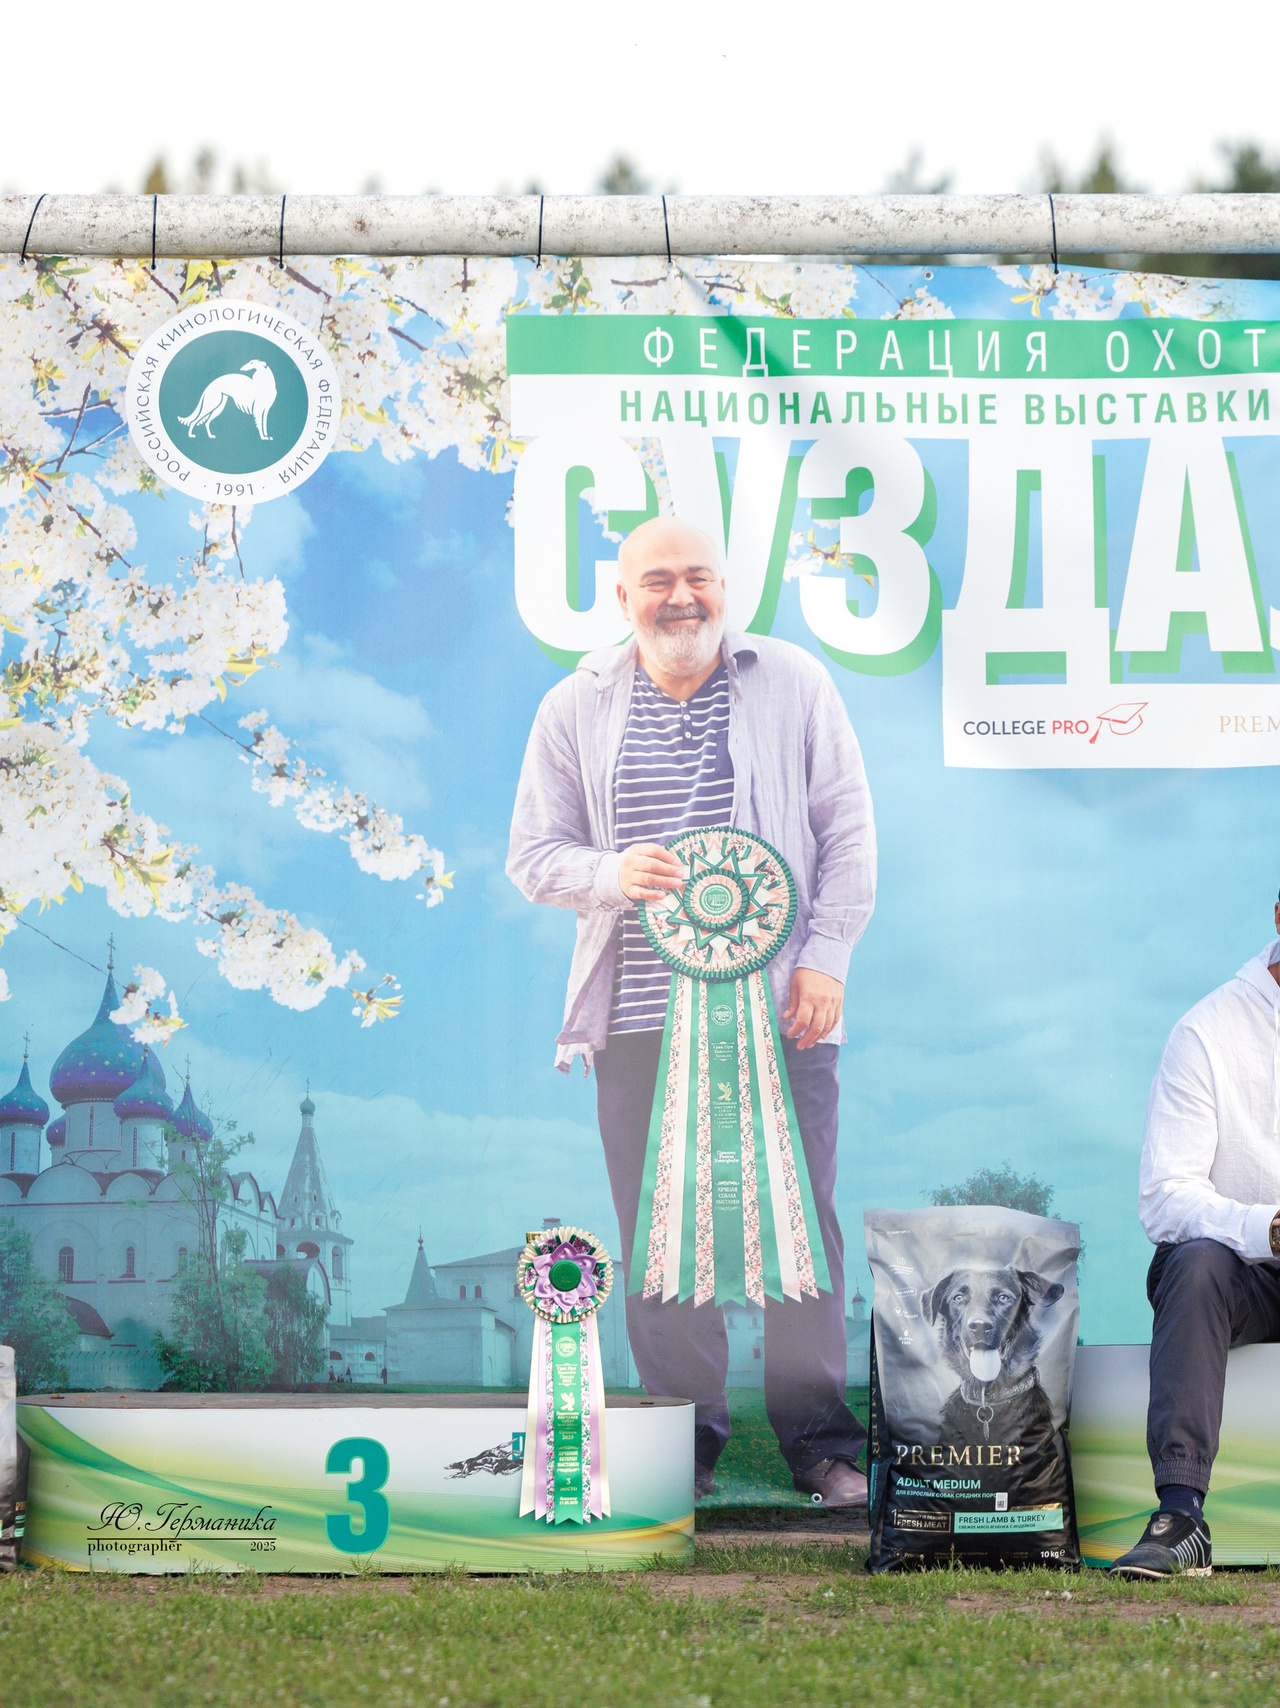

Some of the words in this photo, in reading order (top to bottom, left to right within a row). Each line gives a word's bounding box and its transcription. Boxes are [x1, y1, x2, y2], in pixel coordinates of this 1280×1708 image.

[157, 307, 324, 371] КИНОЛОГИЧЕСКАЯ
[643, 325, 1048, 378] ФЕДЕРАЦИЯ
[136, 356, 191, 482] РОССИЙСКАЯ
[619, 389, 998, 428] НАЦИОНАЛЬНЫЕ
[1024, 388, 1271, 426] ВЫСТАВКИ
[278, 379, 333, 485] ФЕДЕРАЦИЯ
[215, 482, 255, 497] 1991
[963, 719, 1047, 736] COLLEGE
[1052, 719, 1090, 736] PRO
[895, 1444, 1024, 1468] PREMIER
[896, 1476, 931, 1489] ADULT
[933, 1479, 981, 1490] MEDIUM
[324, 1436, 391, 1555] 3
[897, 1519, 922, 1528] FRESH
[924, 1521, 947, 1529] MEAT
[958, 1516, 985, 1524] FRESH
[1016, 1514, 1046, 1523] TURKEY
[1040, 1550, 1049, 1558] 10
[1050, 1550, 1060, 1559] kg
